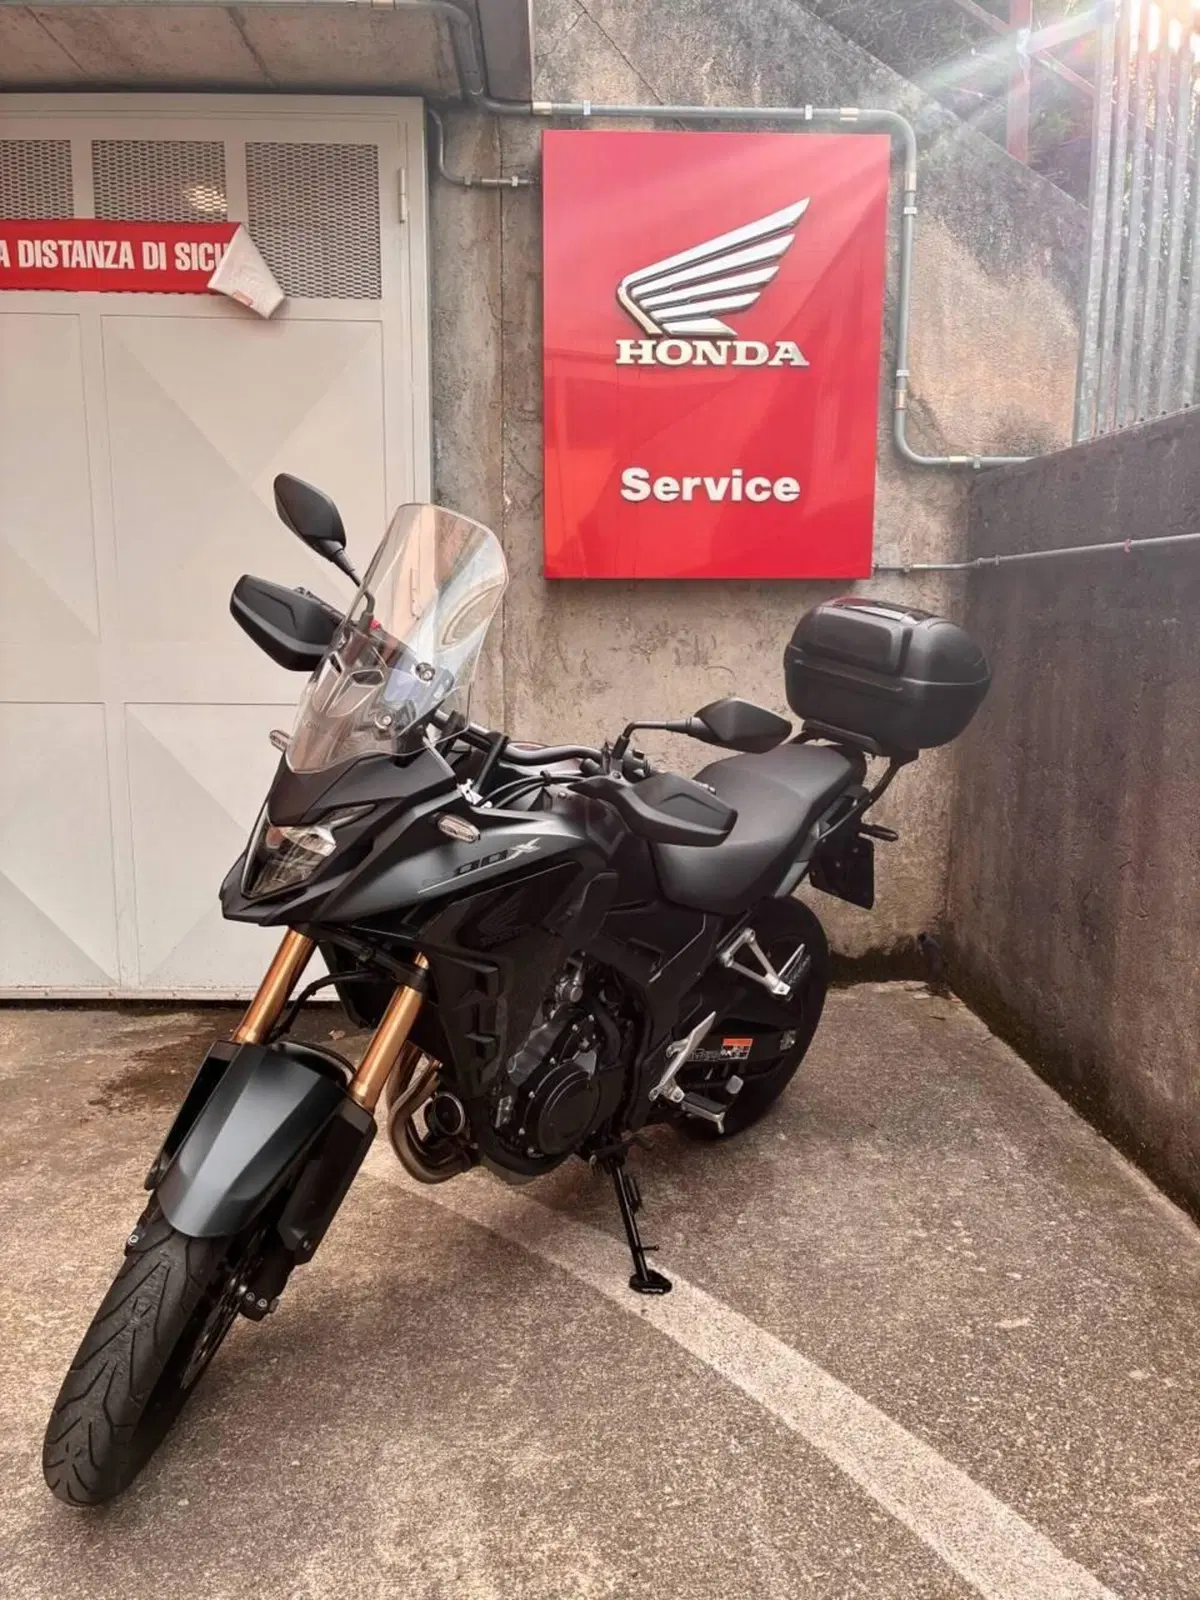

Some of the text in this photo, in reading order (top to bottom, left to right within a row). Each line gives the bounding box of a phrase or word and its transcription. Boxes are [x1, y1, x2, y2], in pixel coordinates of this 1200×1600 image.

[17, 239, 135, 270] DISTANZA
[142, 240, 167, 270] DI
[615, 339, 810, 368] HONDA
[620, 466, 801, 502] Service
